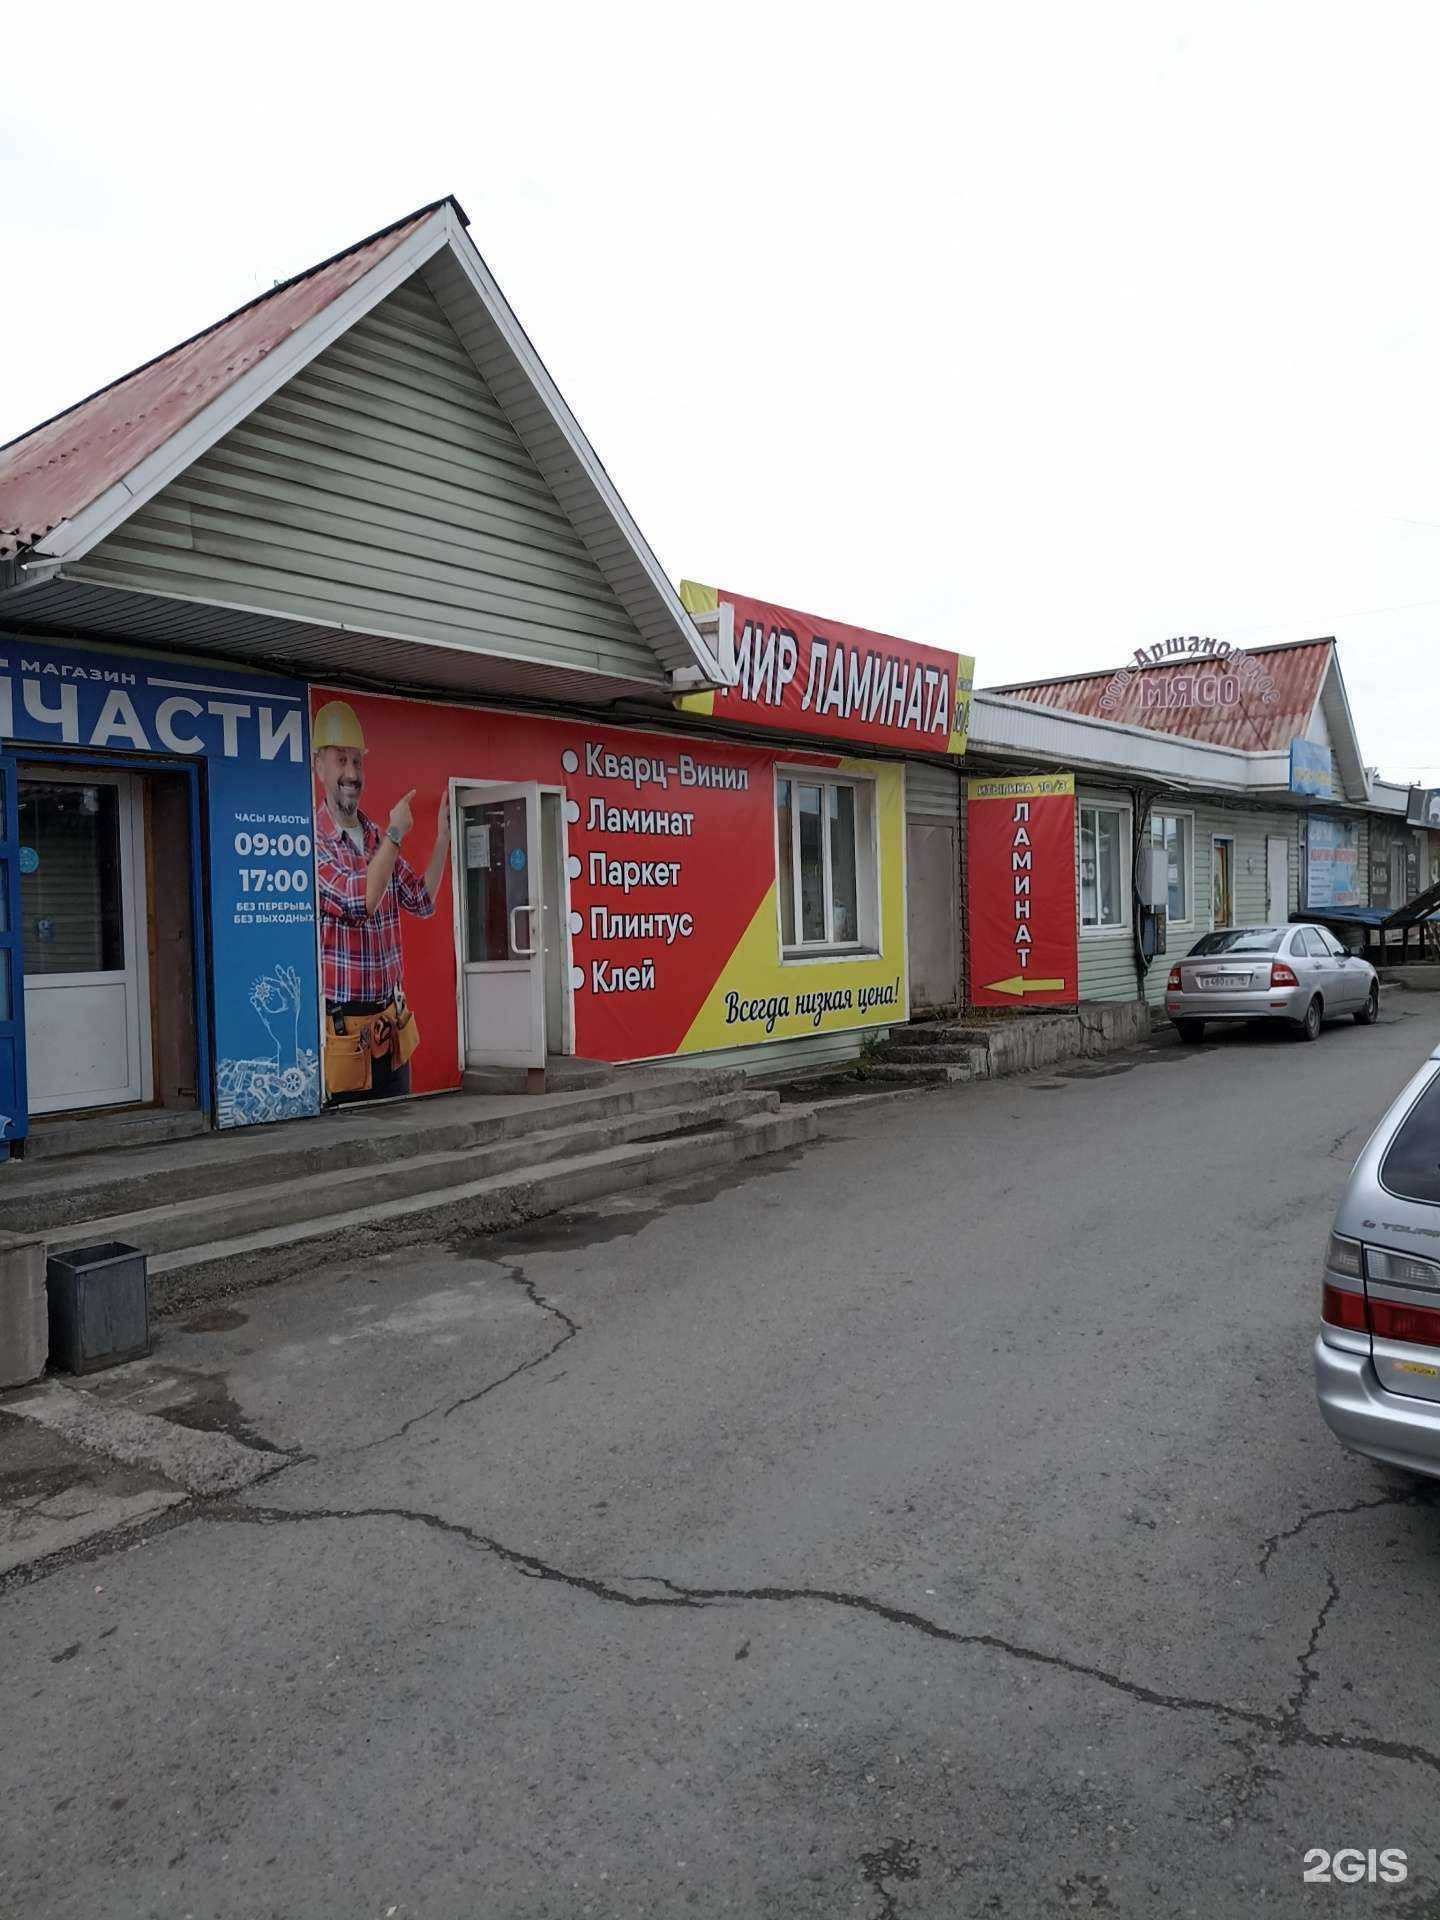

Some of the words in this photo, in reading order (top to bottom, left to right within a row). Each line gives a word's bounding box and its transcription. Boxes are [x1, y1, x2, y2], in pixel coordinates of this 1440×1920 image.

[21, 659, 136, 685] МАГАЗИН
[800, 638, 950, 736] ЛАМИНАТА
[1139, 674, 1241, 709] МЯСО
[0, 676, 304, 763] ЧАСТИ
[585, 742, 749, 790] Кварц-Винил
[234, 812, 266, 823] ЧАСЫ
[268, 814, 310, 825] РАБОТЫ
[586, 797, 694, 837] Ламинат
[234, 832, 311, 857] 09:00
[238, 869, 308, 892] 17:00
[588, 851, 681, 894] Паркет
[1012, 801, 1033, 968] ЛАМИНАТ
[233, 914, 254, 924] БЕЗ
[255, 913, 315, 924] ВЫХОДНЫХ
[236, 902, 256, 912] БЕЗ
[258, 902, 312, 911] ПЕРЕРЫВА
[590, 905, 694, 945] Плинтус
[591, 957, 656, 995] Клей
[725, 990, 790, 1034] Всегда
[795, 989, 853, 1027] низкая
[857, 976, 900, 1015] цена!
